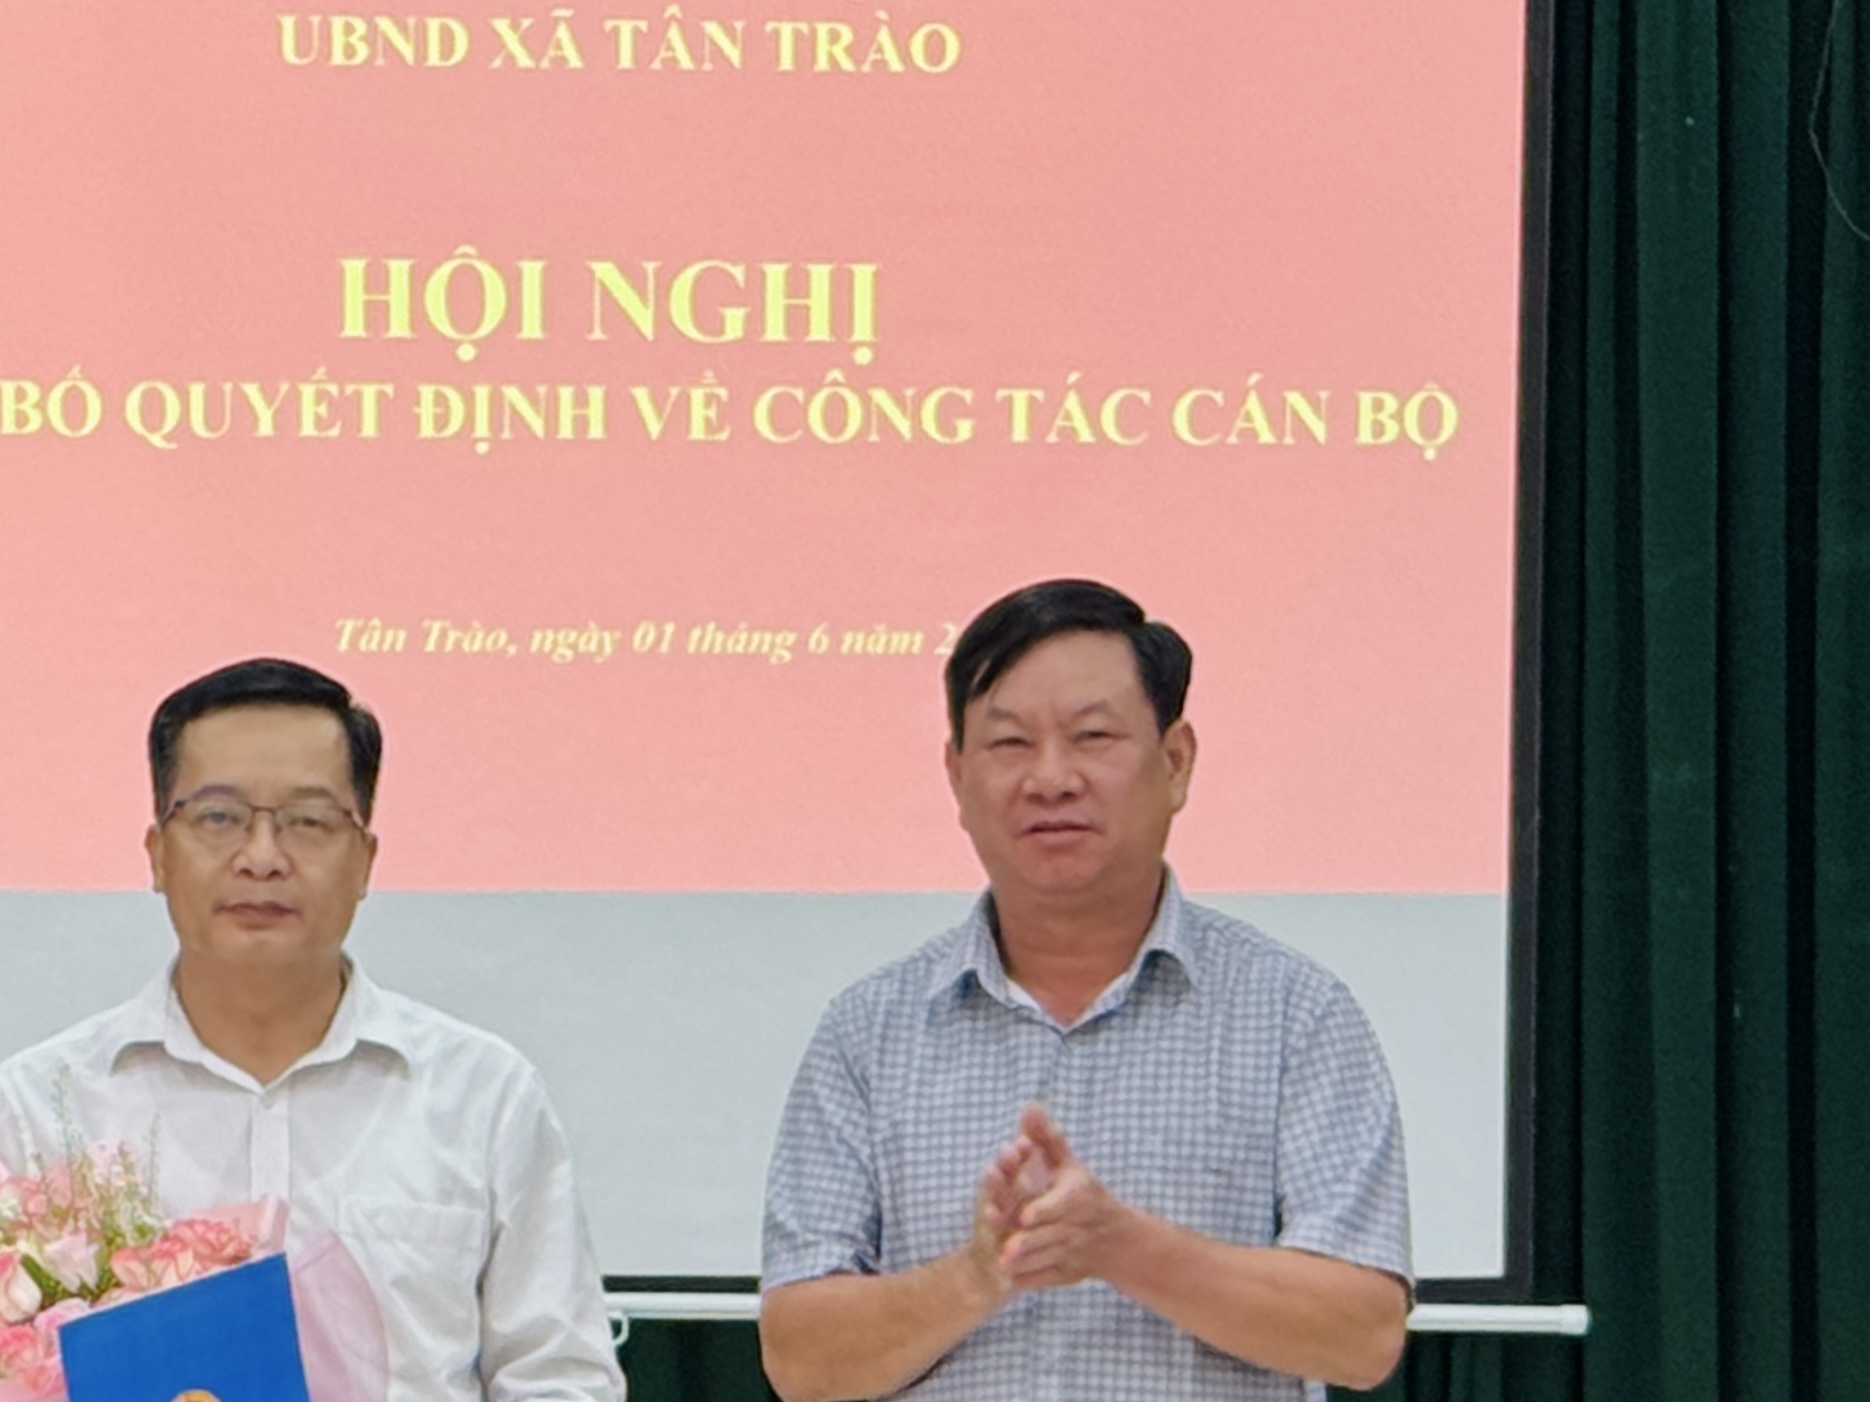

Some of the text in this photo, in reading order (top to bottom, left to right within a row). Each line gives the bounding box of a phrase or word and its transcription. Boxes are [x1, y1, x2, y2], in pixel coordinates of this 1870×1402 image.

[277, 4, 962, 73] UBND XÃ TÂN TRÀO
[338, 244, 879, 366] HỘI NGHỊ
[125, 366, 394, 450] QUYẾT
[413, 382, 607, 455] ĐỊNH
[630, 368, 732, 443] VỀ
[753, 368, 976, 444] CÔNG
[995, 371, 1152, 446] TÁC
[1172, 372, 1330, 446] CÁN
[1355, 380, 1459, 461] BỘ
[335, 617, 407, 653] Tân
[423, 618, 517, 655] Trào,
[530, 619, 622, 664] ngày
[632, 620, 676, 654] 01
[687, 620, 798, 664] tháng
[807, 622, 830, 654] 6
[840, 623, 924, 655] năm
